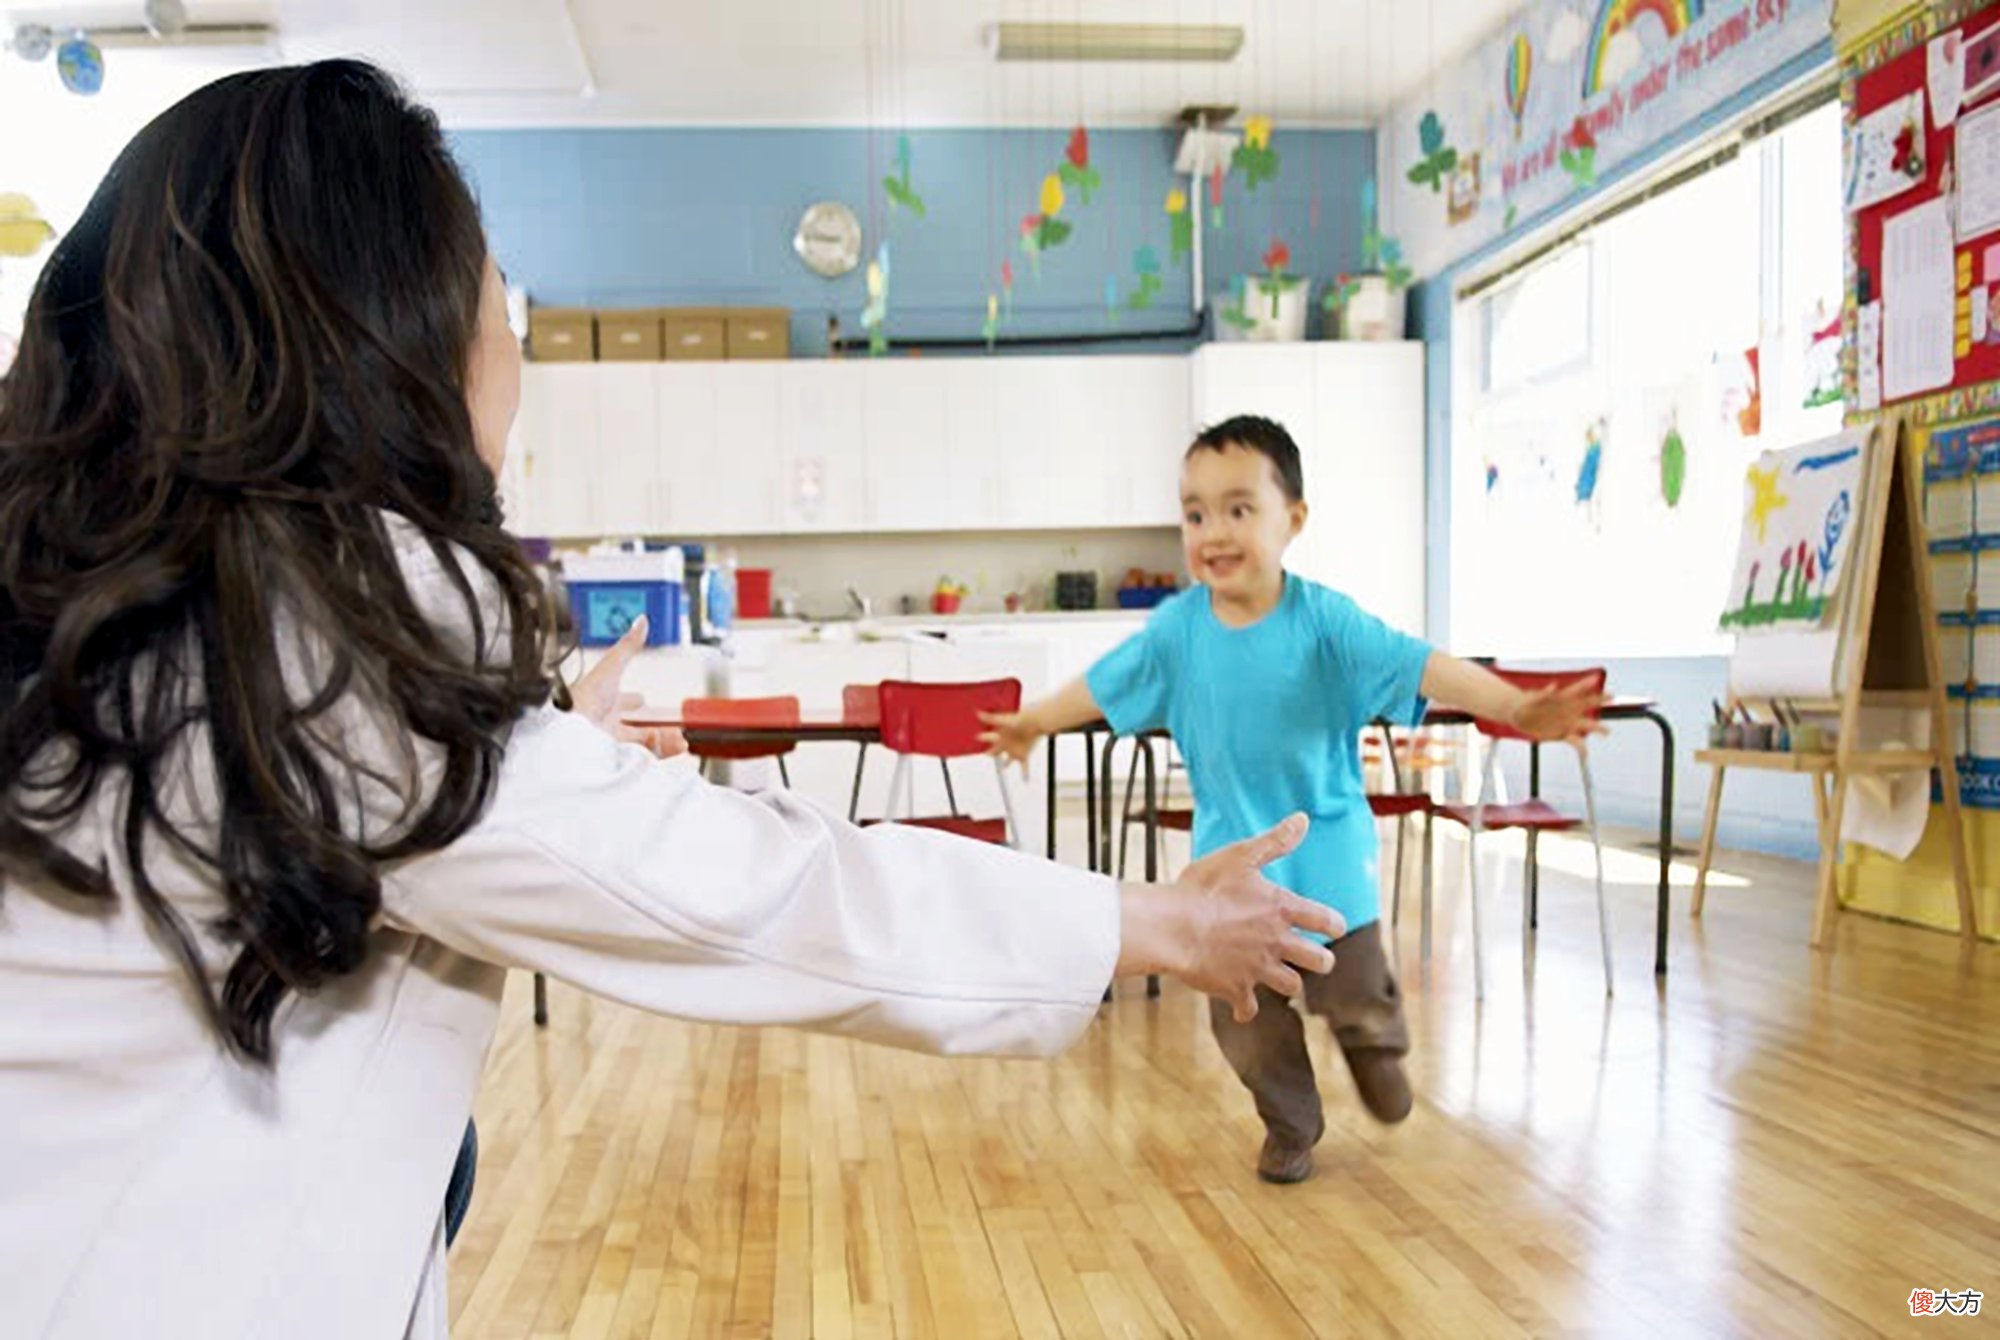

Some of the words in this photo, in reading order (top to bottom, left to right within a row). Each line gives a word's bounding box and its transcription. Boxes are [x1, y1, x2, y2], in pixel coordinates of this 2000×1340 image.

[1631, 63, 1669, 112] under
[1677, 41, 1701, 76] the
[1706, 8, 1749, 61] same
